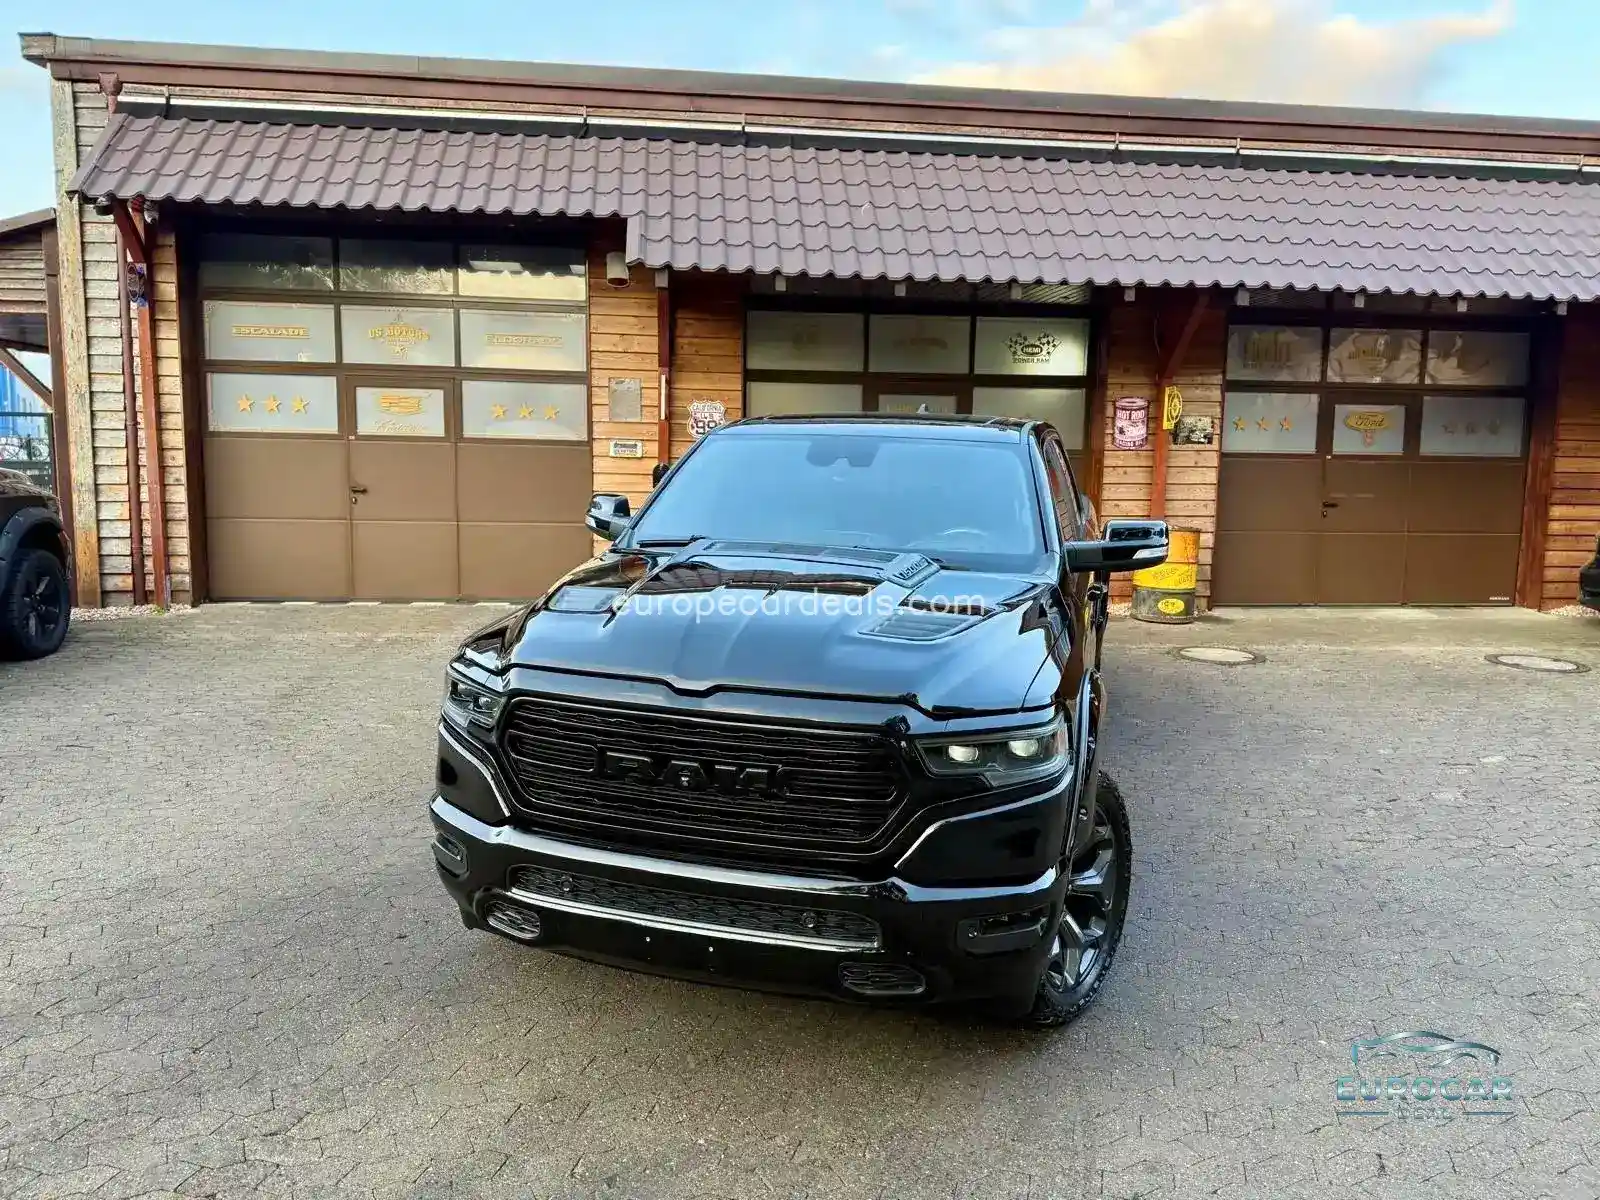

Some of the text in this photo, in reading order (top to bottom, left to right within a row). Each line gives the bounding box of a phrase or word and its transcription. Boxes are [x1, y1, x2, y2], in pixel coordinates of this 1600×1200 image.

[231, 326, 308, 337] ESCALADE
[1116, 410, 1145, 420] HOT ROD
